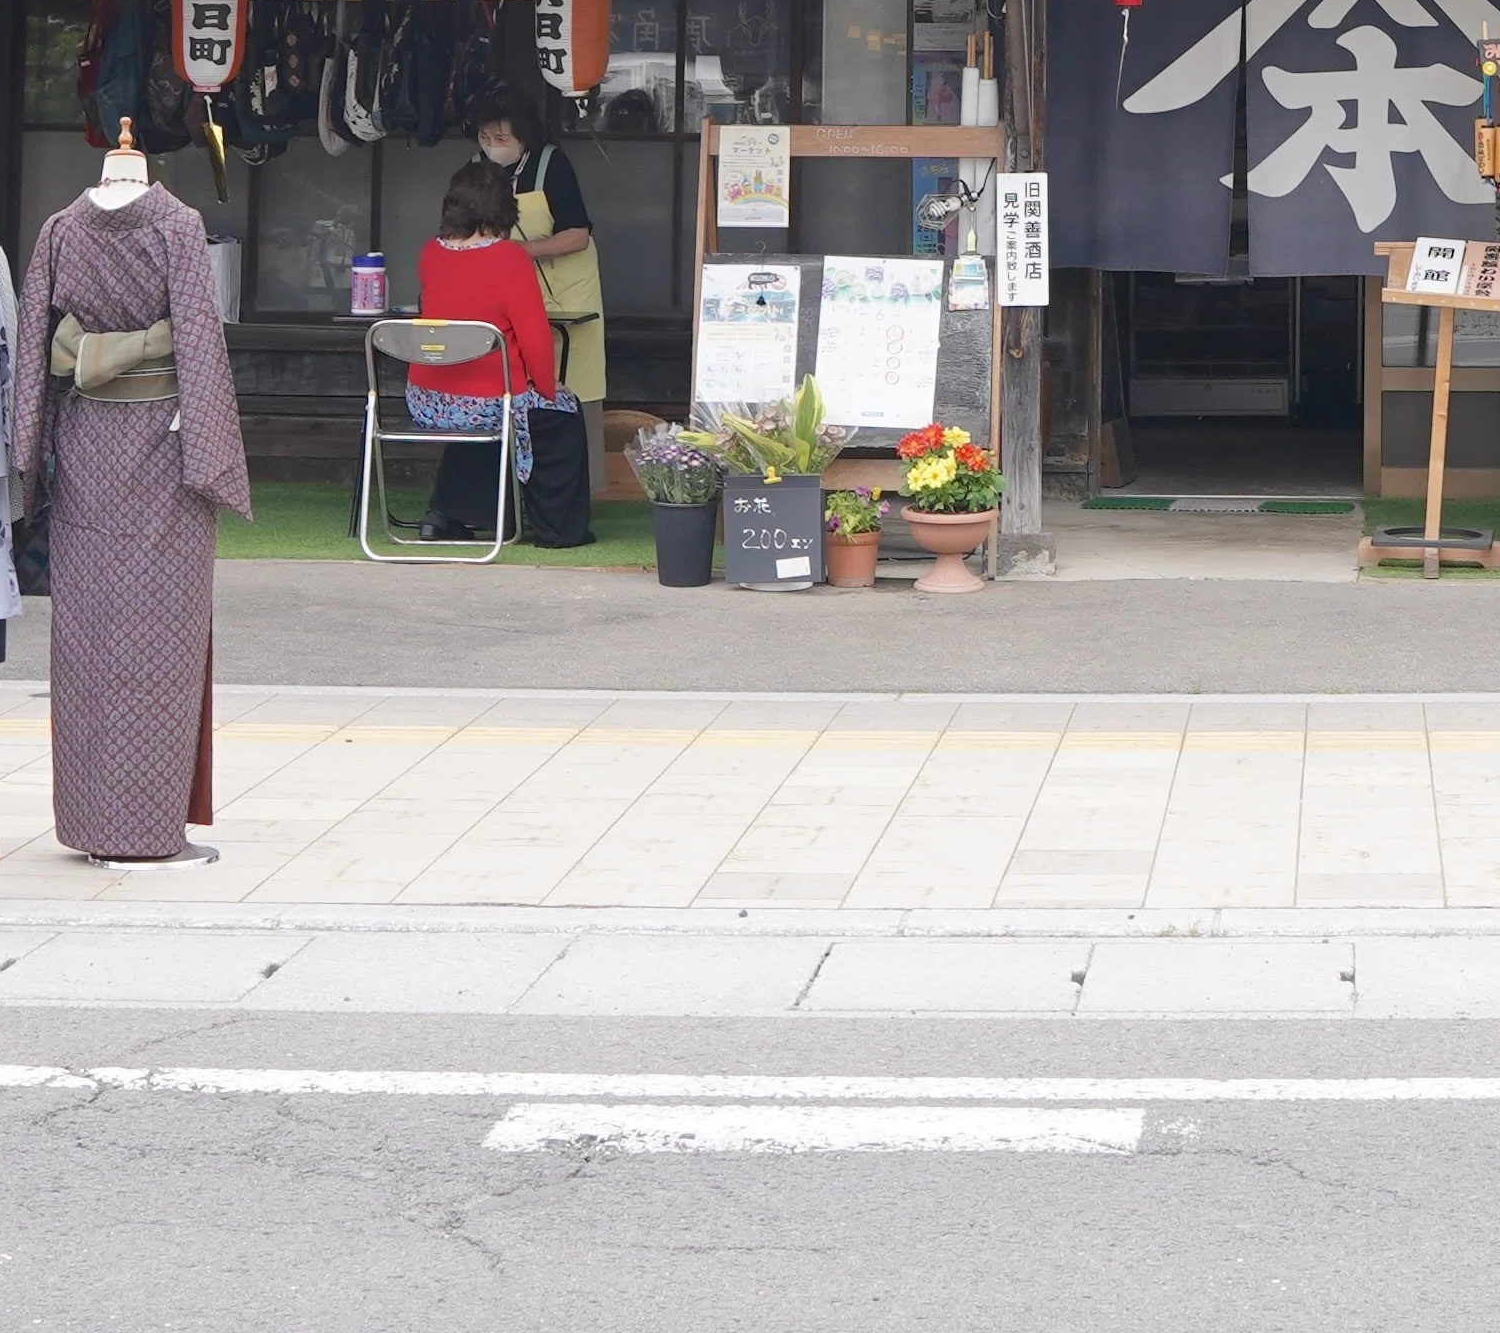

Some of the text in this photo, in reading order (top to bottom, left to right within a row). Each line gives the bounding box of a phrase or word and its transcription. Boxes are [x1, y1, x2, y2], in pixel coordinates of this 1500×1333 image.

[1003, 192, 1019, 302] 見学ご案内致します
[1024, 181, 1042, 280] 旧関善酒店
[733, 496, 772, 514] お花
[741, 528, 814, 550] 200エン
